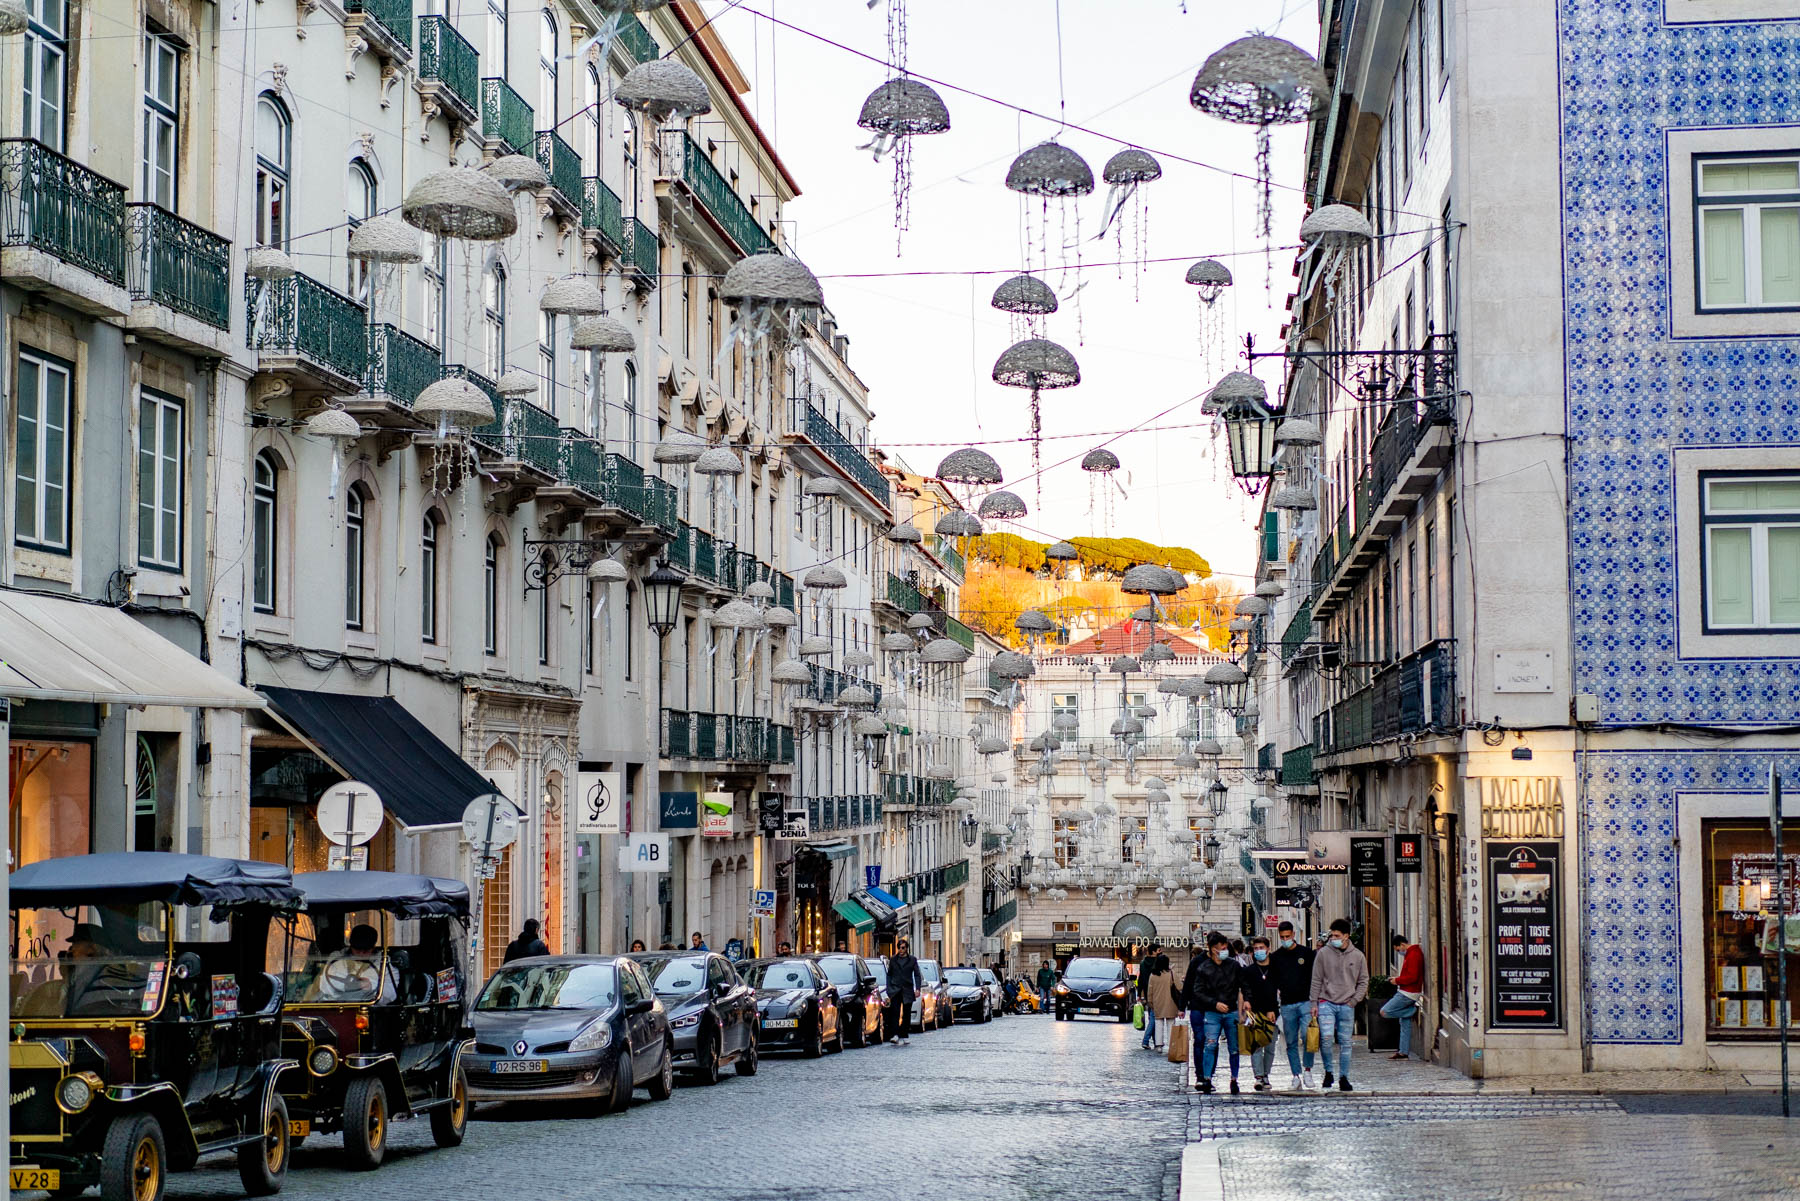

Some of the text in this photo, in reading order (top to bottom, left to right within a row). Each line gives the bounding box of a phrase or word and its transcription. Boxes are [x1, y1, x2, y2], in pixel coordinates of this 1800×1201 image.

[1480, 777, 1564, 807] LIVRARIA
[1481, 805, 1564, 838] BERTRAND
[637, 843, 659, 861] AB
[1470, 839, 1480, 1028] FUNDADA EM 1732
[1498, 925, 1522, 937] PROVE
[1528, 925, 1551, 937] TASTE
[1079, 936, 1189, 948] ARMAZENS DO CHIADO
[1498, 944, 1523, 955] LIVROS
[1528, 944, 1552, 955] BOOKS
